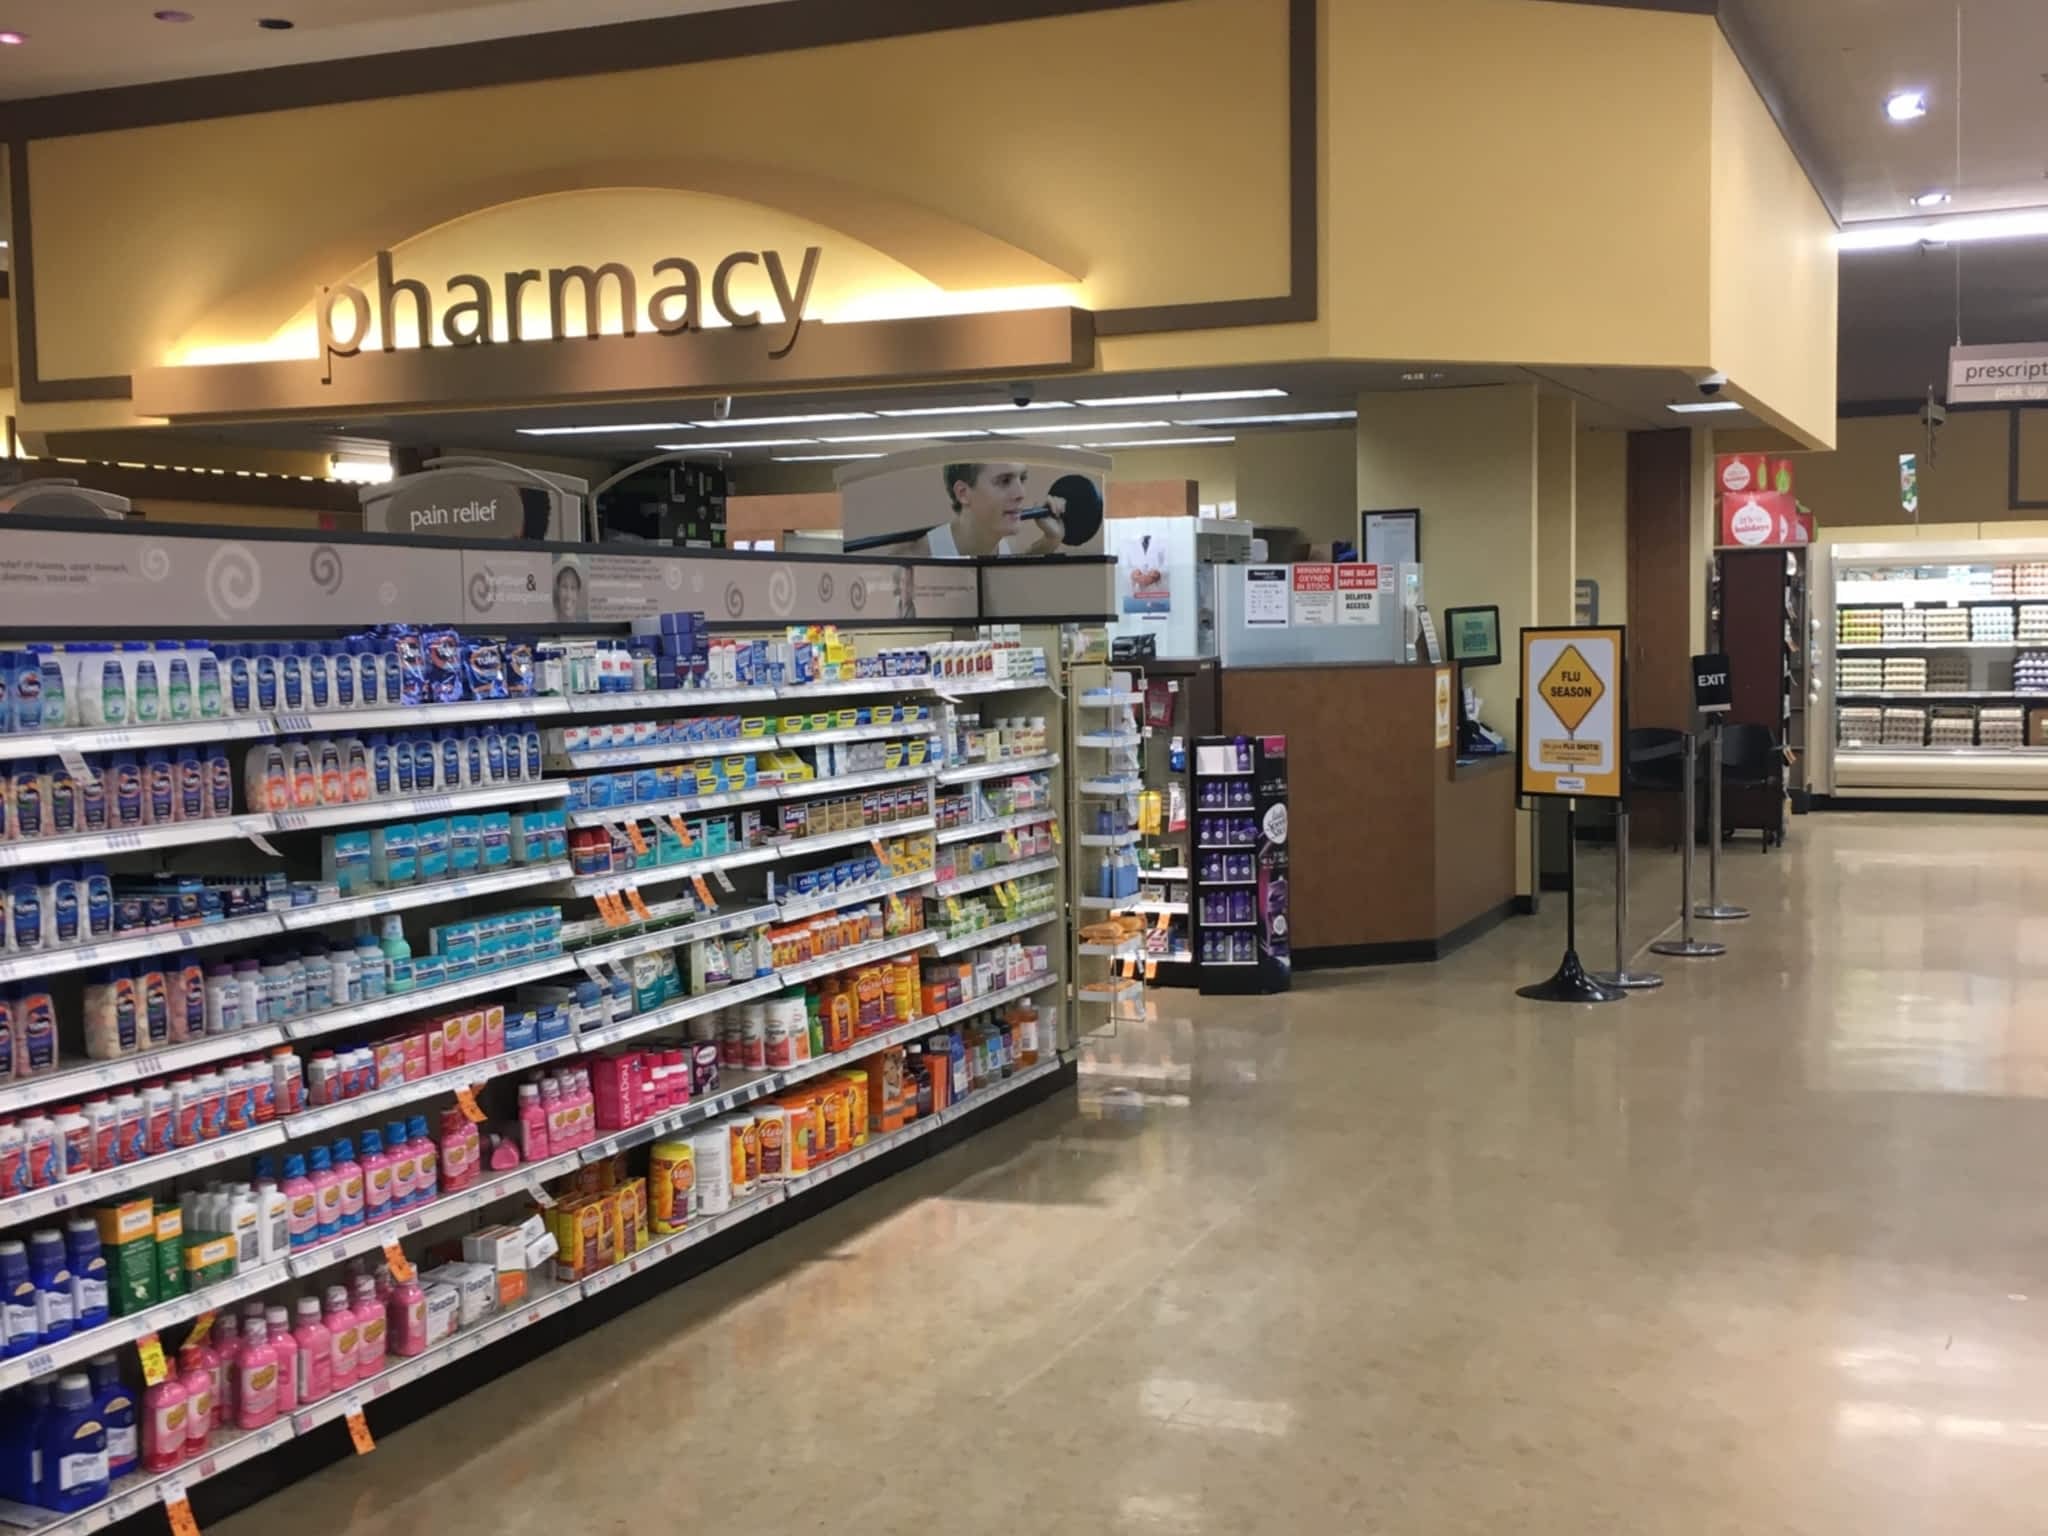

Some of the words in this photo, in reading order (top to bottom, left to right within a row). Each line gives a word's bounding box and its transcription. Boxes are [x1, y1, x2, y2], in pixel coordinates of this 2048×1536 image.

[317, 247, 822, 384] pharmacy
[1966, 360, 2048, 382] prescript
[410, 504, 448, 532] pain
[453, 499, 497, 523] relief
[1356, 569, 1376, 577] DELAY
[526, 573, 537, 592] &
[1345, 593, 1373, 601] DELAYED
[1561, 672, 1581, 682] FLU
[1697, 673, 1727, 687] EXIT
[1550, 687, 1592, 698] SEASON
